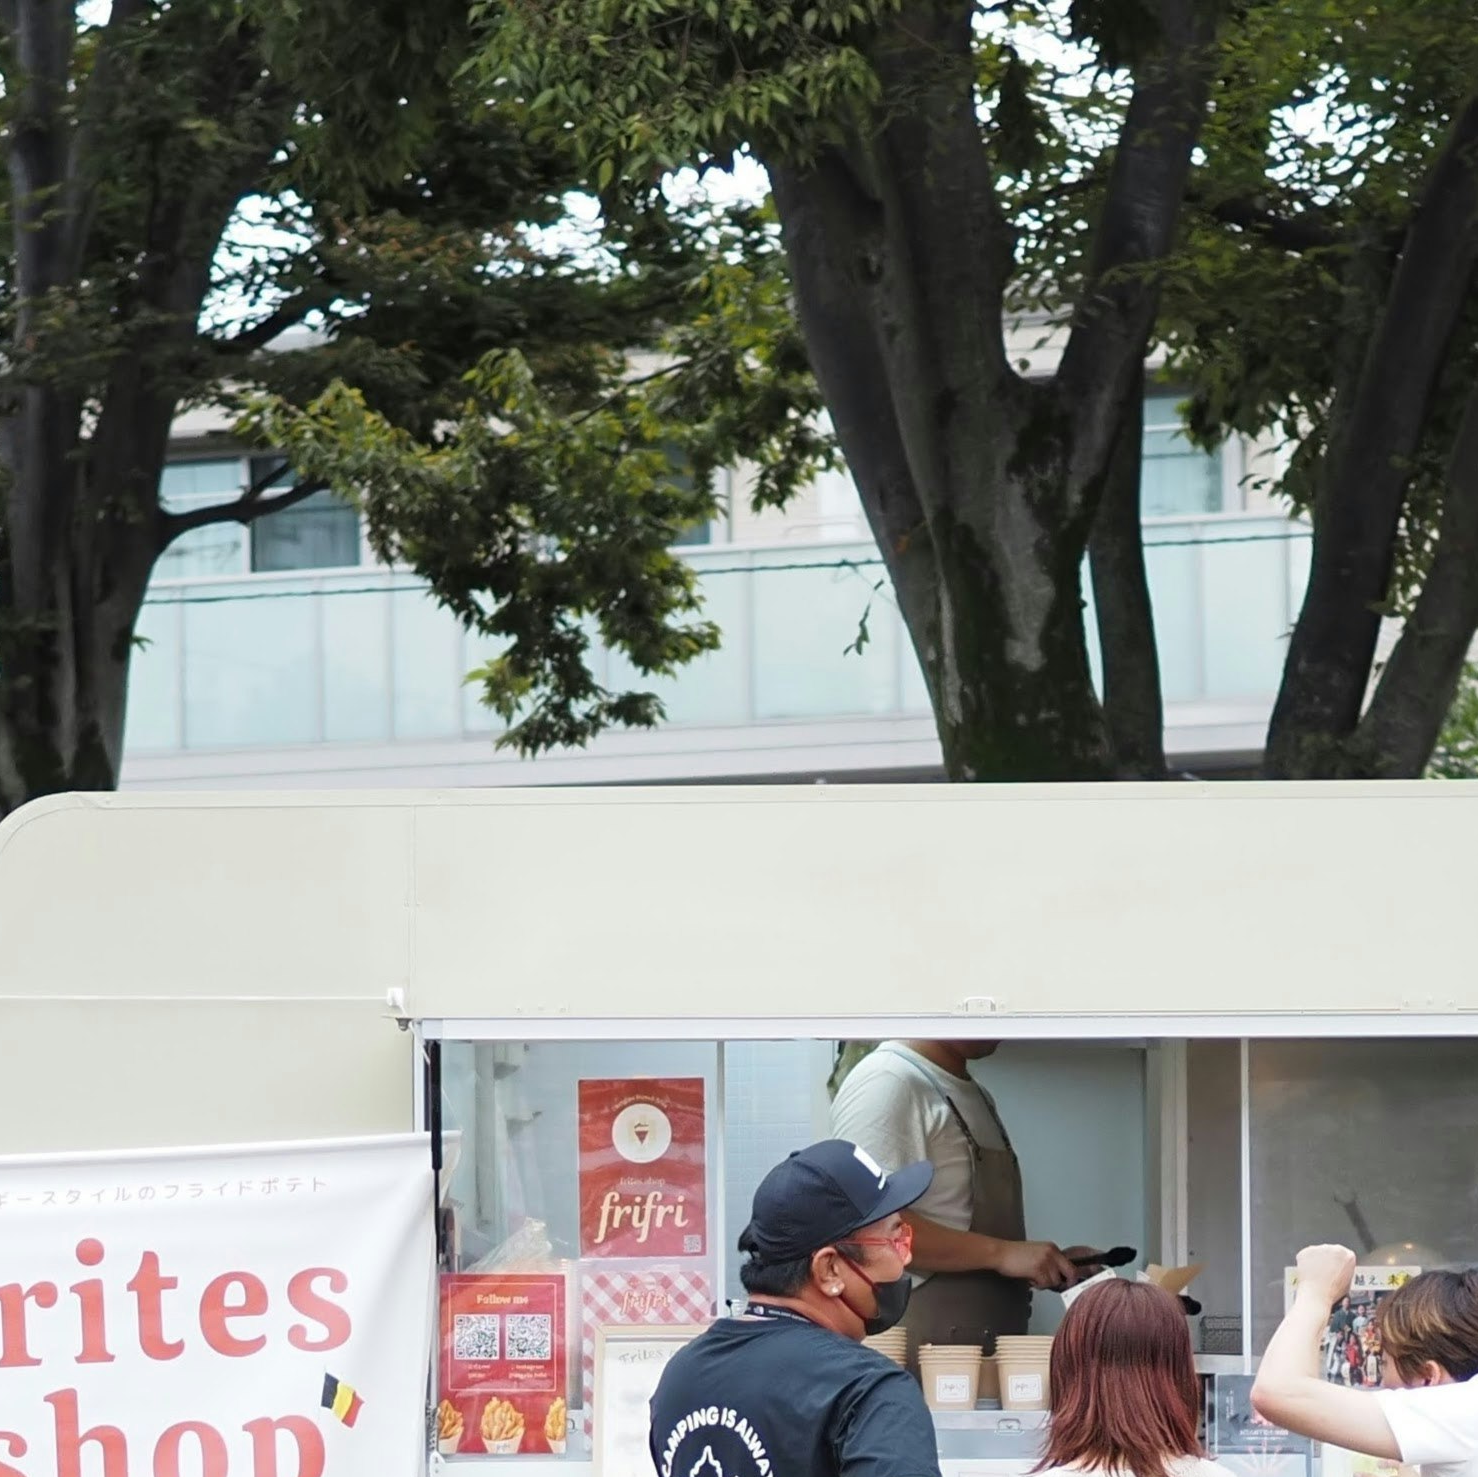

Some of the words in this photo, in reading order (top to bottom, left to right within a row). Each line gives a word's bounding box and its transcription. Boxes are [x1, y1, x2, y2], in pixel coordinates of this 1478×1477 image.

[593, 1190, 689, 1244] frifri
[476, 1294, 512, 1305] Follow
[619, 1289, 670, 1316] frifri
[720, 1406, 738, 1429] IS
